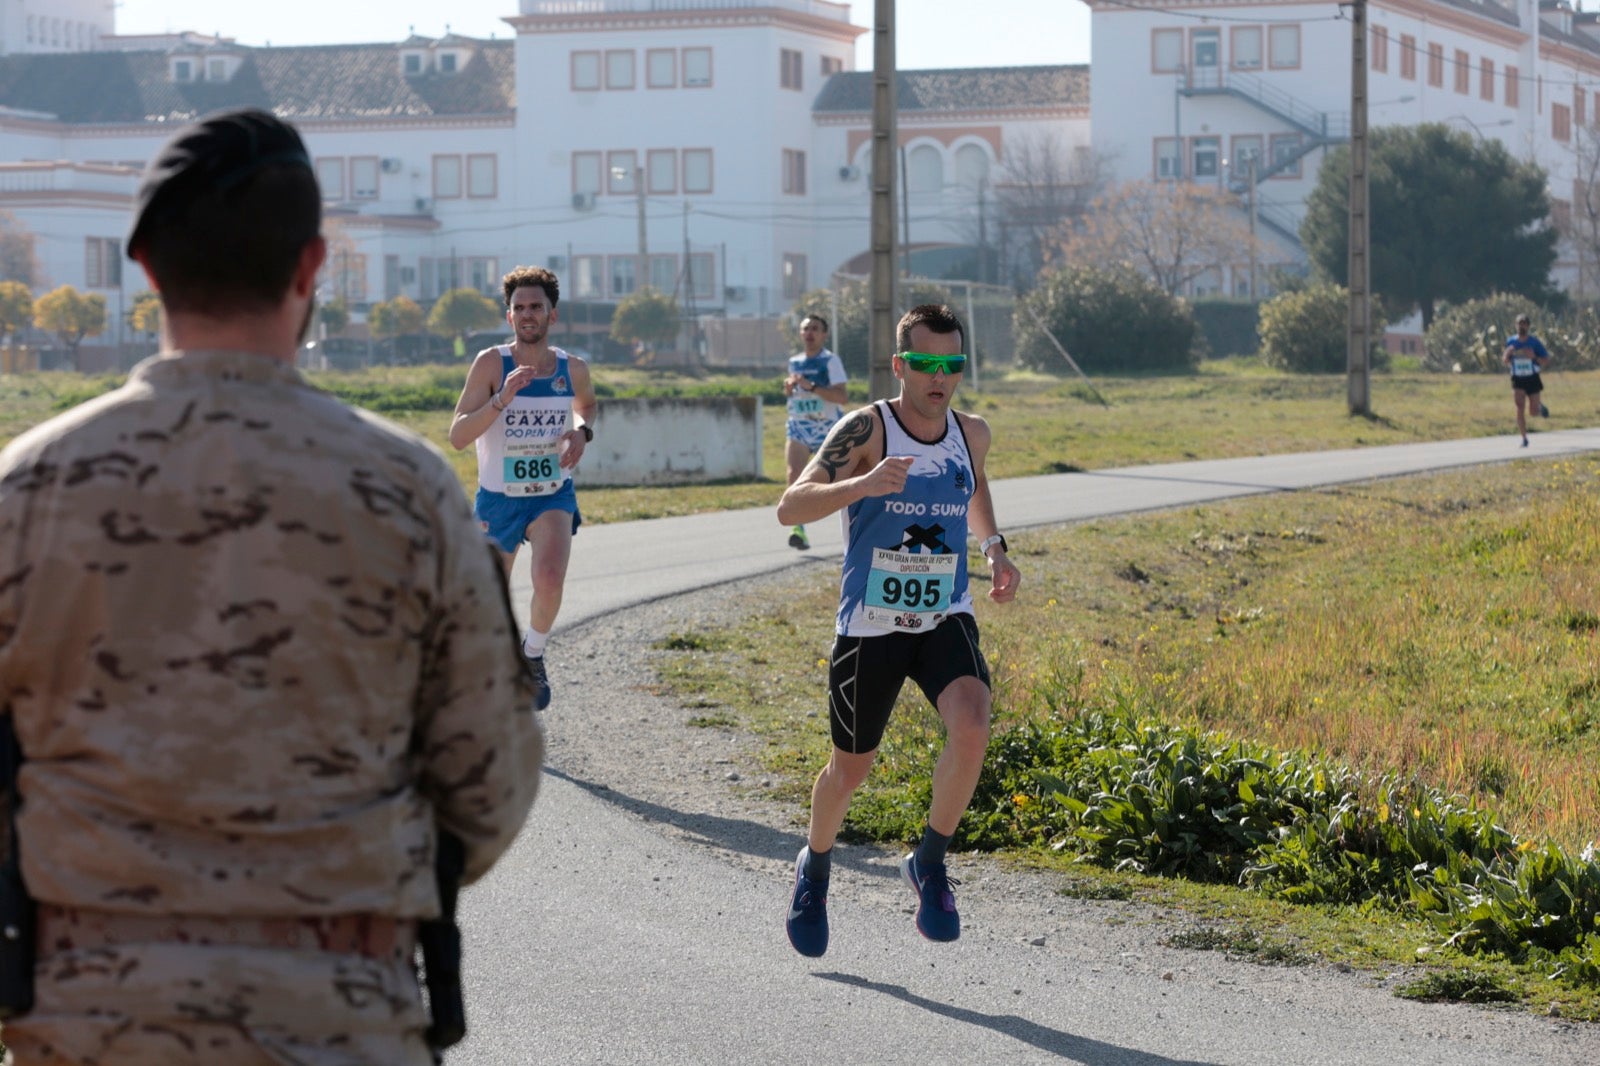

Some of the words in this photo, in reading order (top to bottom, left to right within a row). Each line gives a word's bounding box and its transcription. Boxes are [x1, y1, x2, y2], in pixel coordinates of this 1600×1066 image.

[514, 458, 552, 479] 686
[885, 501, 926, 515] TODO
[894, 553, 909, 563] GRAN
[909, 555, 929, 564] PREMIO
[928, 556, 936, 564] DE
[882, 577, 941, 608] 995
